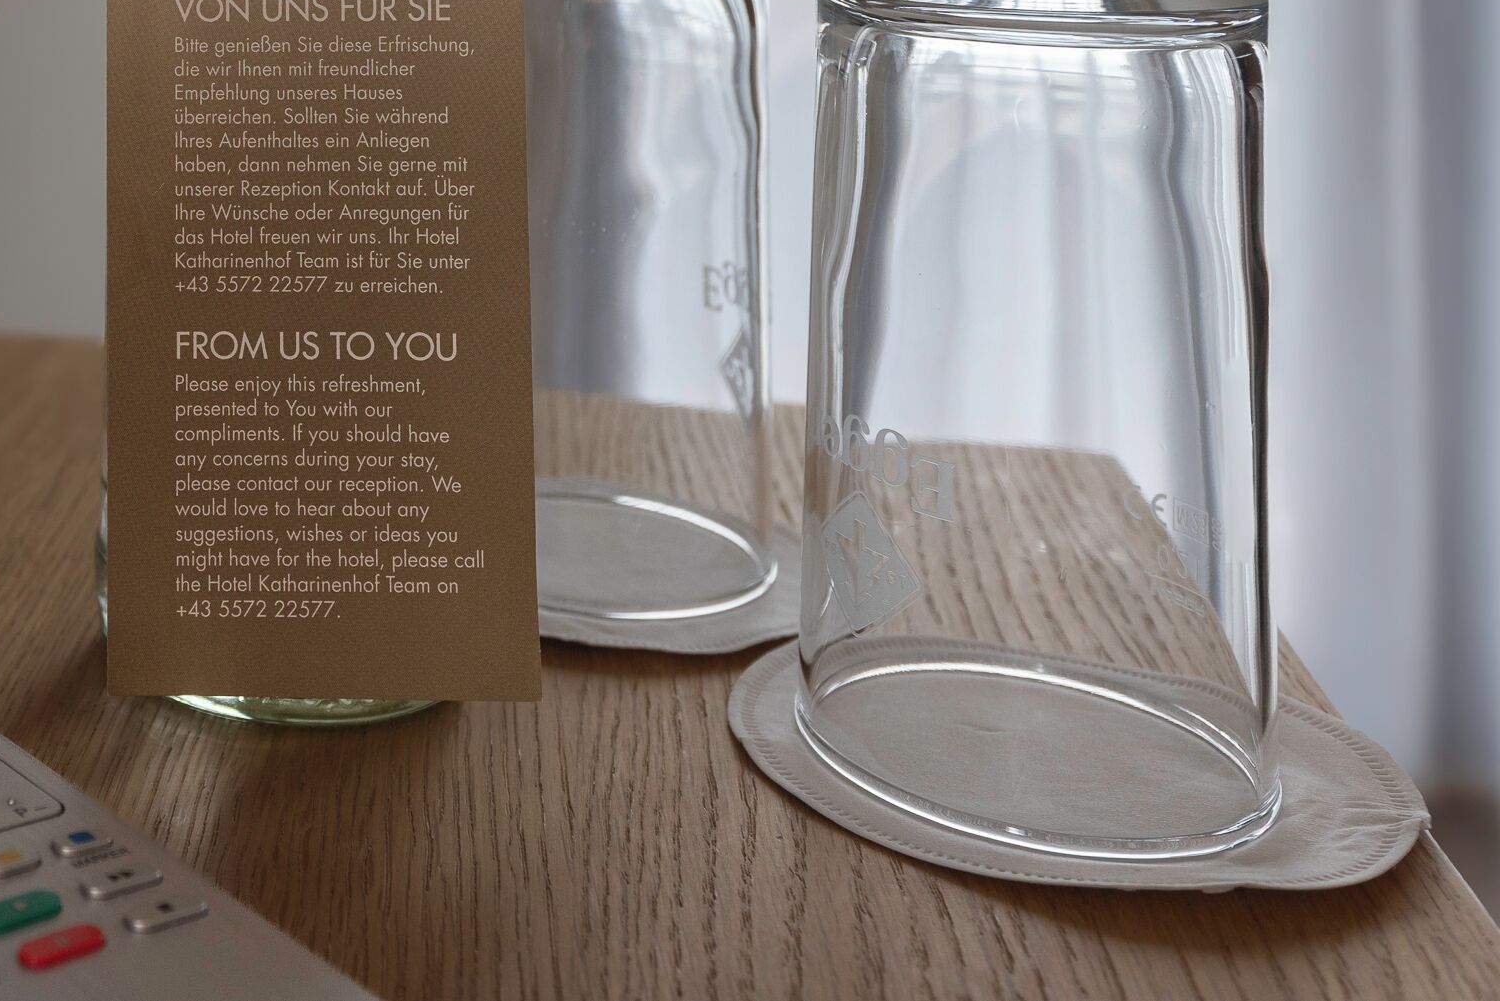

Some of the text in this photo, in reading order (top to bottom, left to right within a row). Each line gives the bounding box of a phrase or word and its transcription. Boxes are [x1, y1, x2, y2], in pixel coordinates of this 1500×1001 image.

[174, 34, 474, 58] Bitte genießen Sie diese Erfrischung,
[174, 58, 415, 77] die wir Ihnen mit freundlicher
[174, 81, 403, 105] Empfehlung unseres Hauses
[174, 105, 448, 124] überreichen. Sollten Sie während
[174, 129, 430, 153] Ihres Aufenthaltes ein Anliegen
[174, 154, 468, 177] haben, dann nehmen Sie gerne mit
[174, 175, 475, 201] unserer Rezeption Kontakt auf. Über
[174, 202, 470, 225] Ihre Wünsche oder Anregungen für
[174, 225, 459, 245] das Hotel freuen wir uns. Ihr Hotel
[174, 249, 470, 269] Katharinenhof Team ist für Sie unter
[174, 275, 443, 294] +43 5572 22577 zu erreichen.
[176, 330, 457, 361] FROM US TO YOU
[175, 373, 425, 397] Please enjoy this refreshment,
[175, 398, 393, 422] presented to You with our
[174, 422, 450, 447] compliments. If you should have
[175, 447, 438, 473] any concerns during your stay,
[175, 472, 462, 497] please contact our reception. We
[174, 497, 430, 523] would love to hear about any
[175, 523, 458, 548] suggestions, wishes or ideas you
[176, 547, 484, 573] might have for the hotel, please call
[175, 573, 458, 594] the Hotel Katharinenhof Team on
[176, 599, 340, 618] +43 5572 22577.
